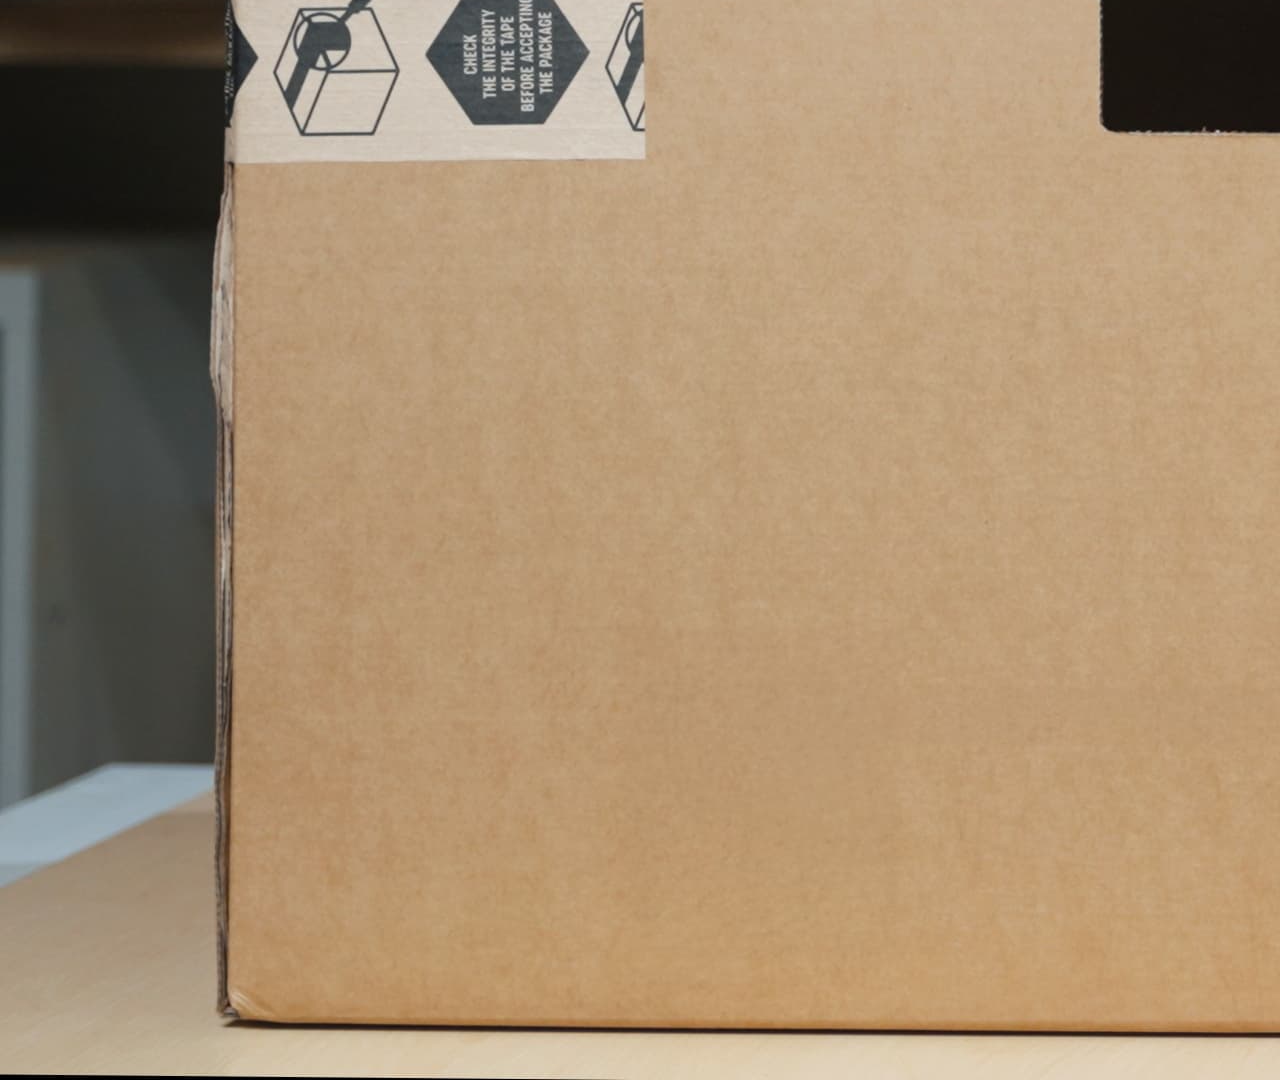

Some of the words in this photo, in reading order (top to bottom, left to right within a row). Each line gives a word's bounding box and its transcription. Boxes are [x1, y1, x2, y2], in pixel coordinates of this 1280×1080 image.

[481, 9, 496, 72] INTEGRITY
[500, 16, 515, 46] TAPE
[538, 11, 553, 68] PACKAGE
[463, 34, 478, 75] CHECK
[500, 49, 515, 73] THE
[482, 75, 497, 99] THE
[501, 76, 515, 92] OF
[520, 65, 535, 112] BEFORE
[539, 71, 553, 94] THE
